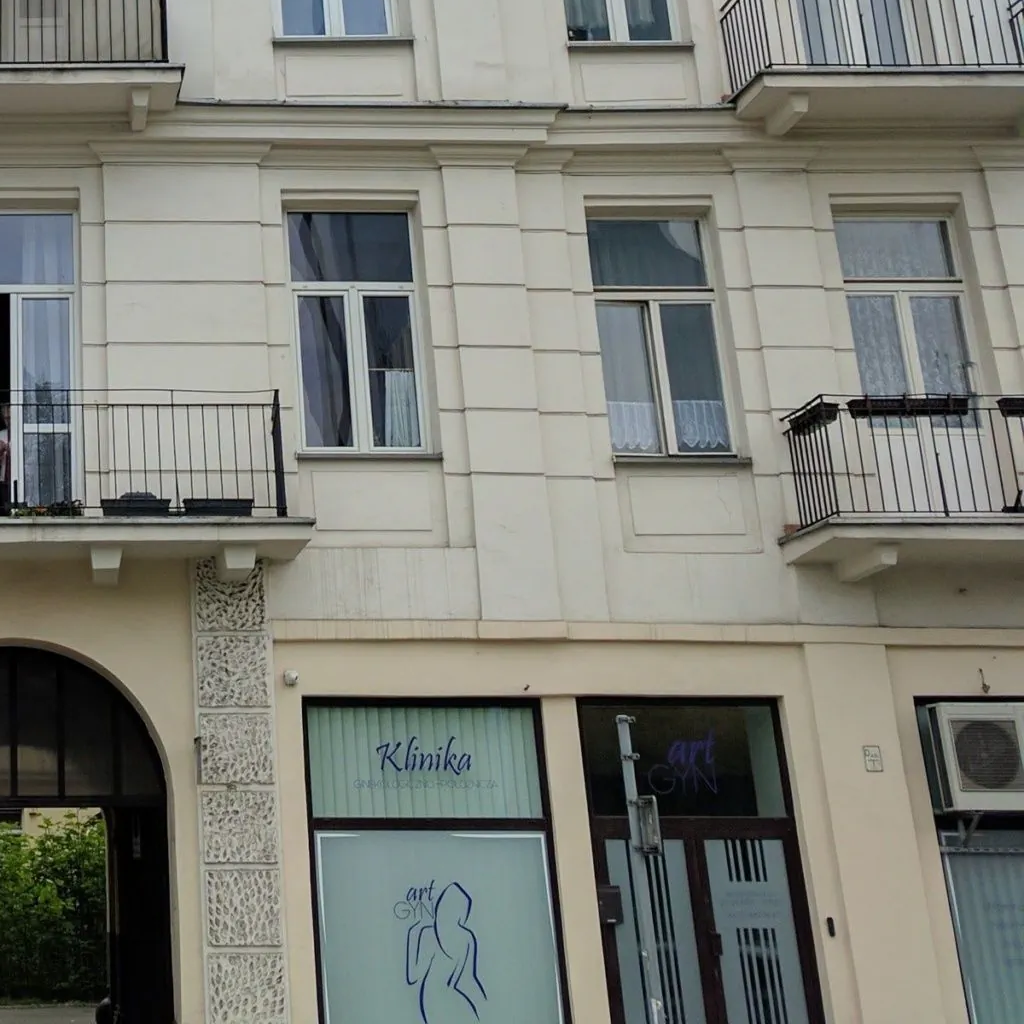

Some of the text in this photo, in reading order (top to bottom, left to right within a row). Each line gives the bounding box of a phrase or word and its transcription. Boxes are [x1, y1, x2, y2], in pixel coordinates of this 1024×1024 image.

[376, 736, 473, 776] Klinika
[667, 728, 716, 764] art
[406, 879, 436, 902] art
[393, 900, 435, 920] GYN
